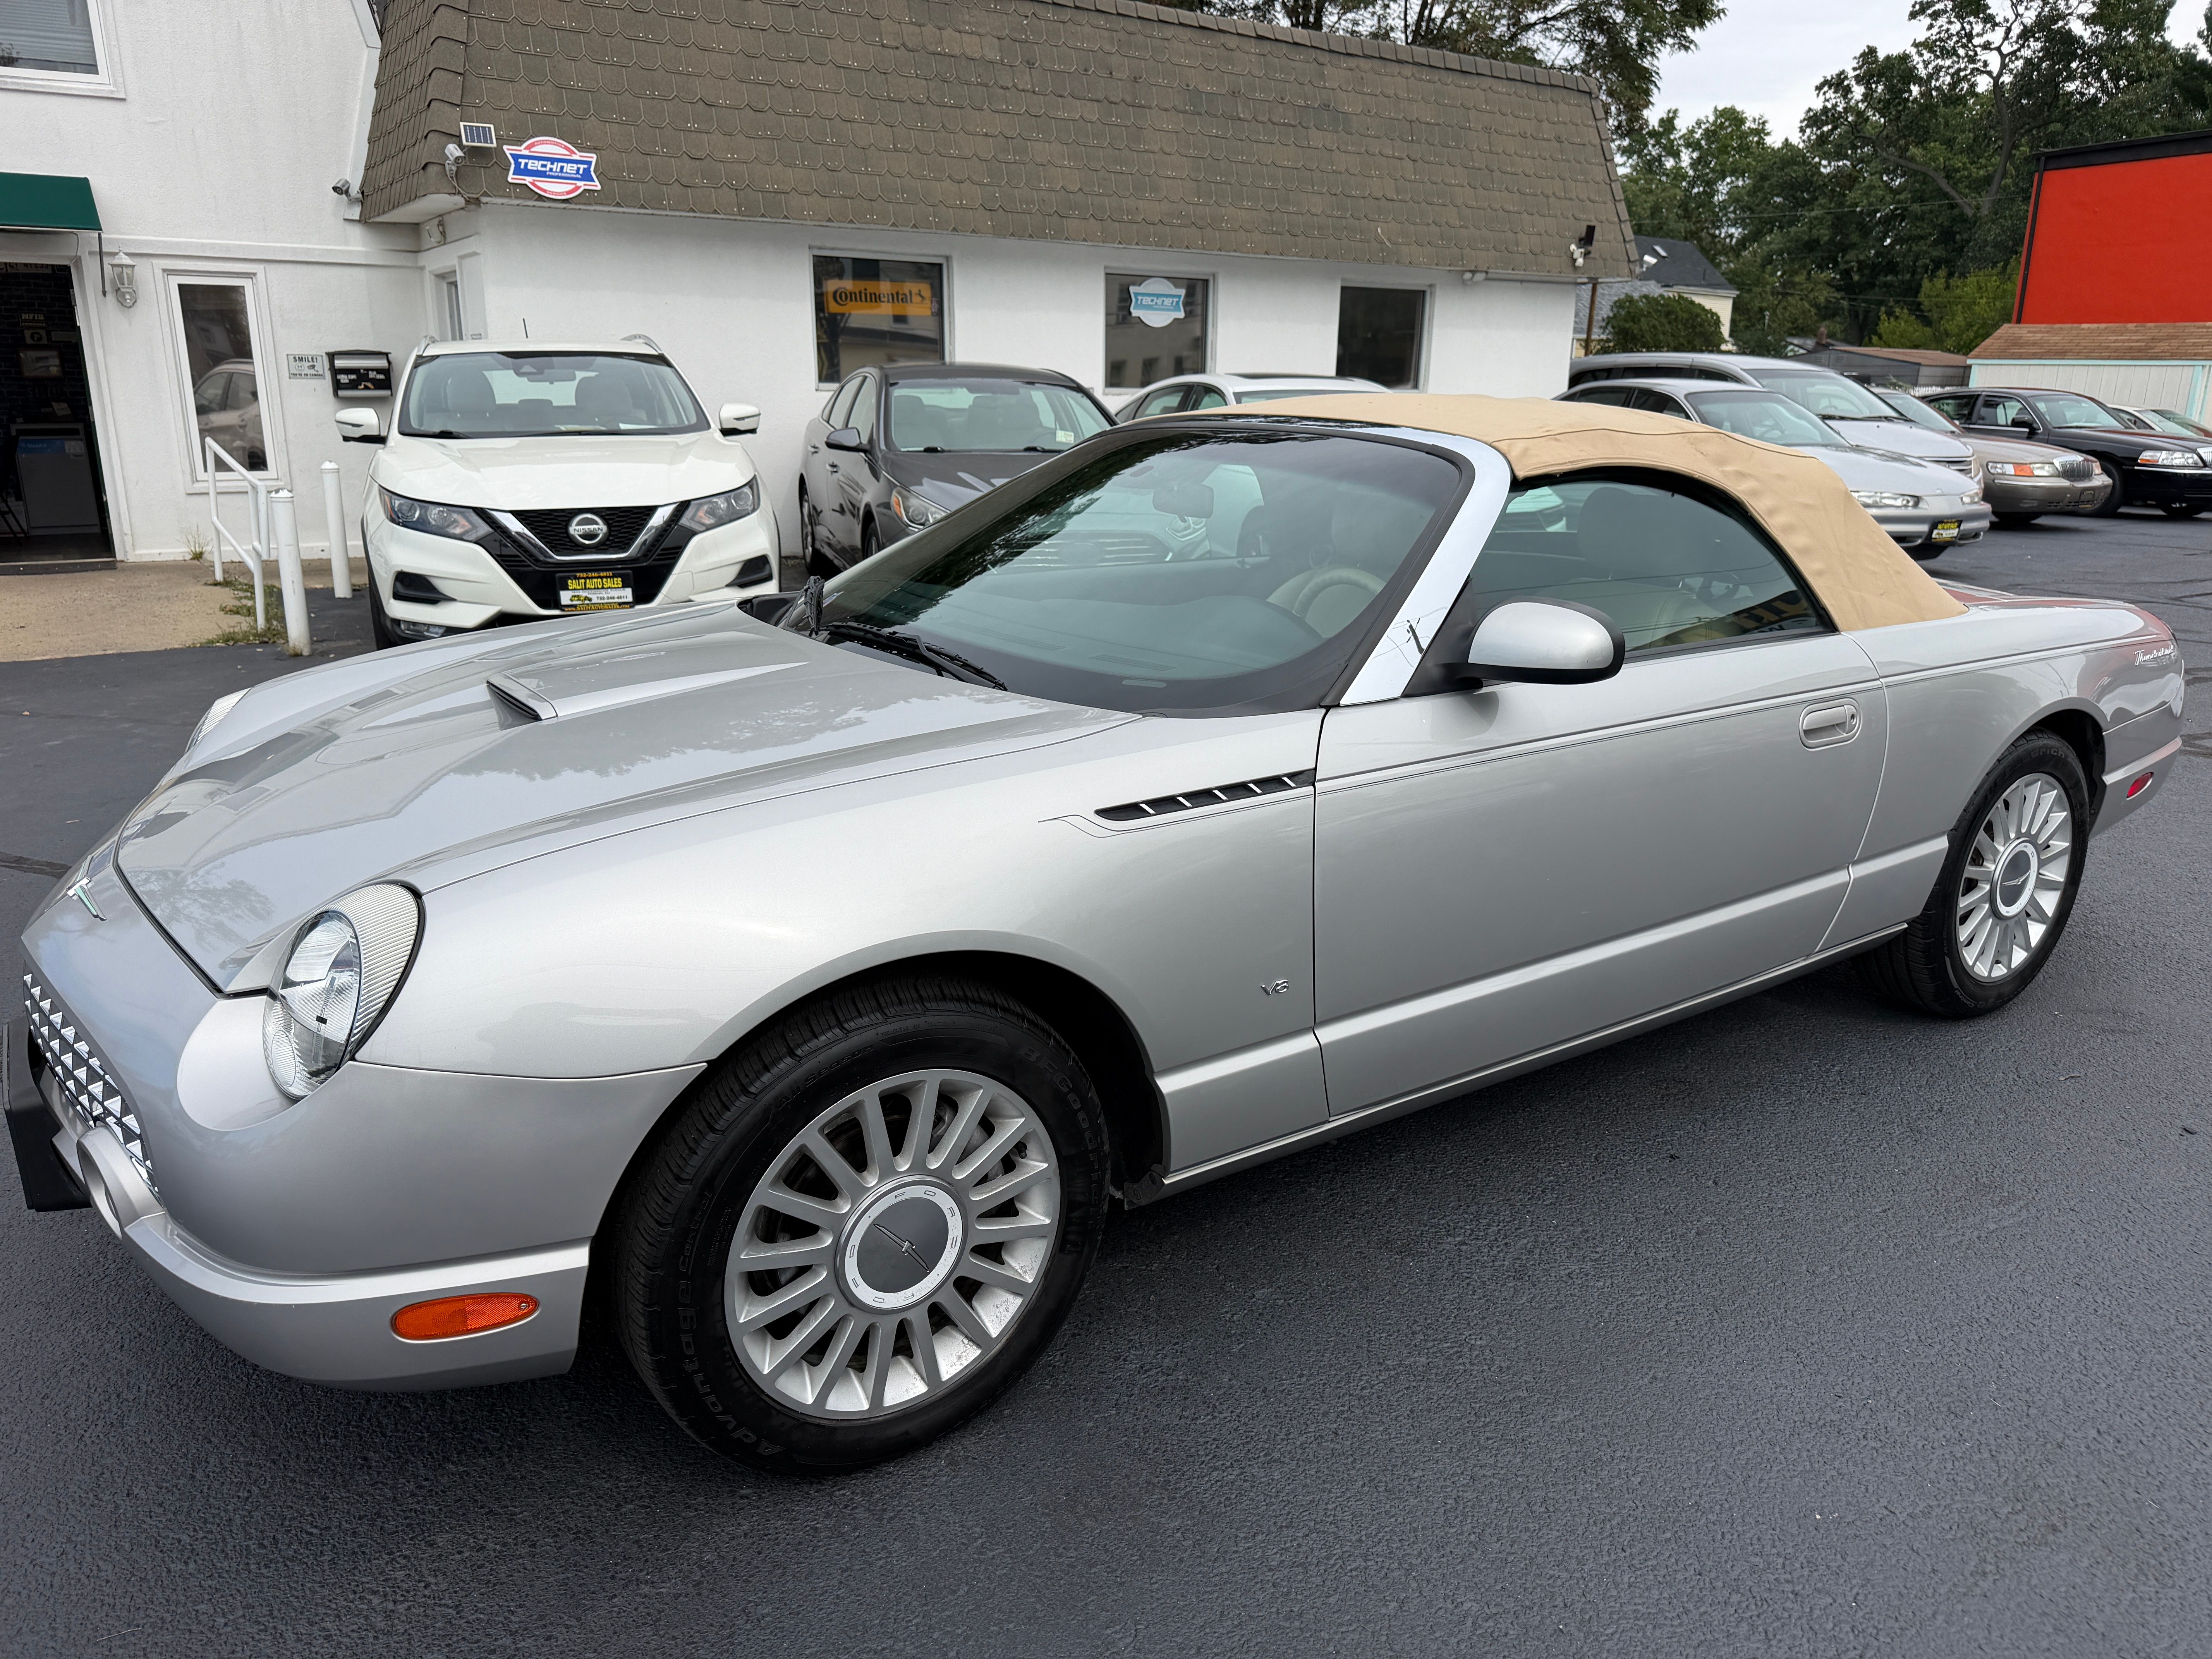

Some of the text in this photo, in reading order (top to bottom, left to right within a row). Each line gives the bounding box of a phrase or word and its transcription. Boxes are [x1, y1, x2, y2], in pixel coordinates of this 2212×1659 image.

[518, 158, 588, 174] TECHNET
[832, 287, 913, 306] Continental
[1137, 296, 1178, 306] TECHNET
[568, 577, 622, 589] SALIT AUTO SALES
[1260, 979, 1290, 996] V8
[895, 1190, 958, 1249] FORD
[679, 1192, 713, 1271] Control
[678, 1281, 786, 1456] Advantage
